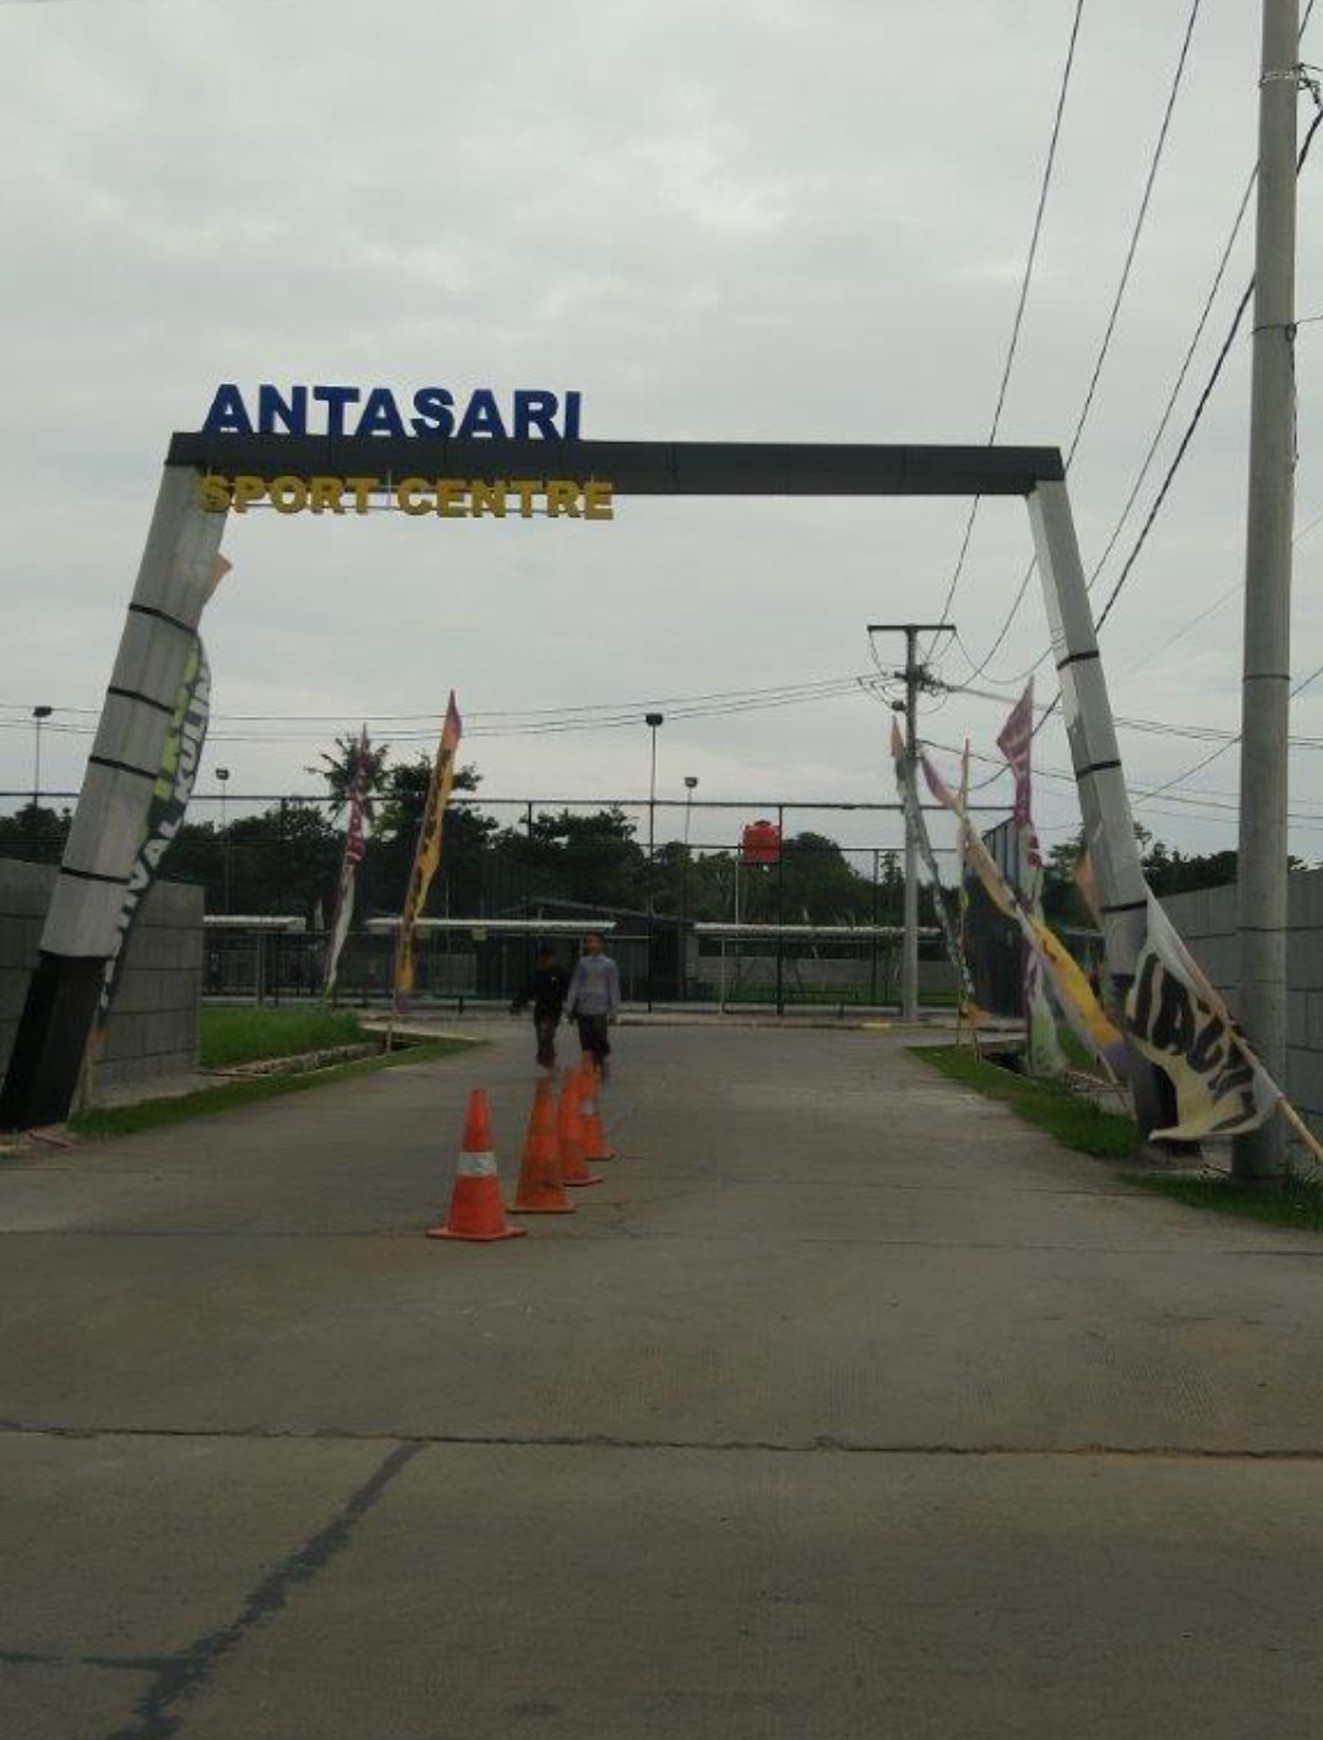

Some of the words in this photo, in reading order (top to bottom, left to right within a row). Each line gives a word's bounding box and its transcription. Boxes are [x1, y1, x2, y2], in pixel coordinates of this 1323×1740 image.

[200, 384, 582, 443] ANTASARI
[201, 475, 380, 514] SPORT
[397, 477, 614, 520] CENTRE
